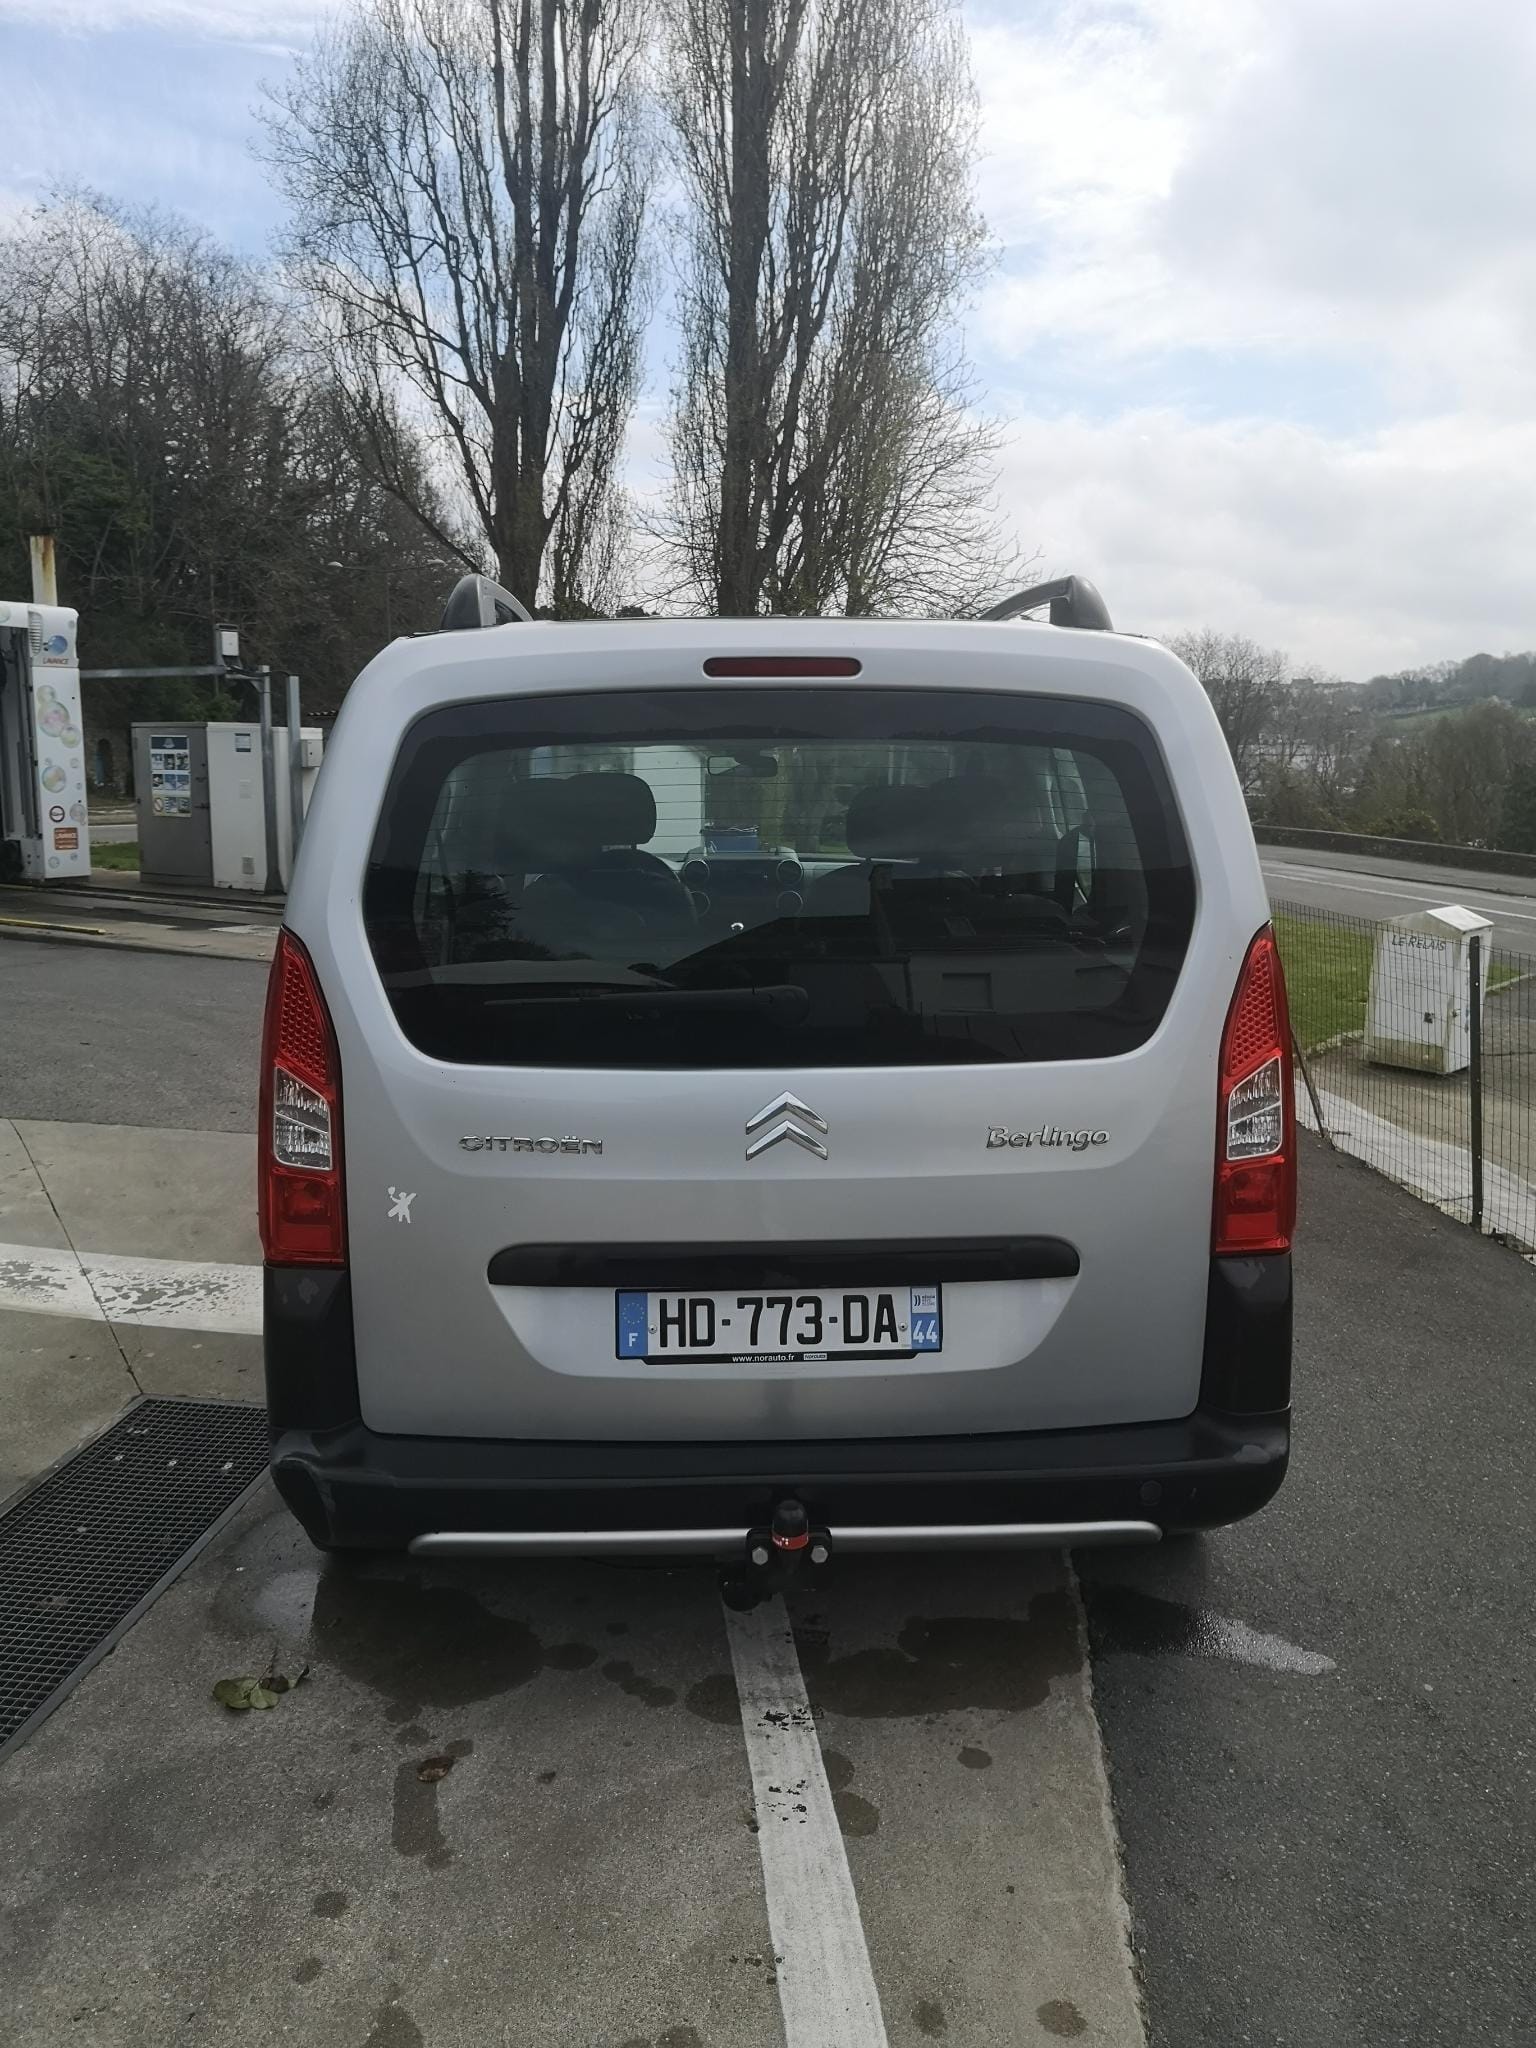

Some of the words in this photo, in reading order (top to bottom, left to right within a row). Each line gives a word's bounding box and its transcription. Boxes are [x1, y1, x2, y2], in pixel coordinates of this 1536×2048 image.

[458, 1135, 603, 1155] CITROËN
[986, 1125, 1110, 1152] Berlingo
[659, 1294, 898, 1348] HD-773-DA
[912, 1319, 938, 1343] 44
[628, 1333, 638, 1346] F
[732, 1353, 795, 1363] www.norauto.fr
